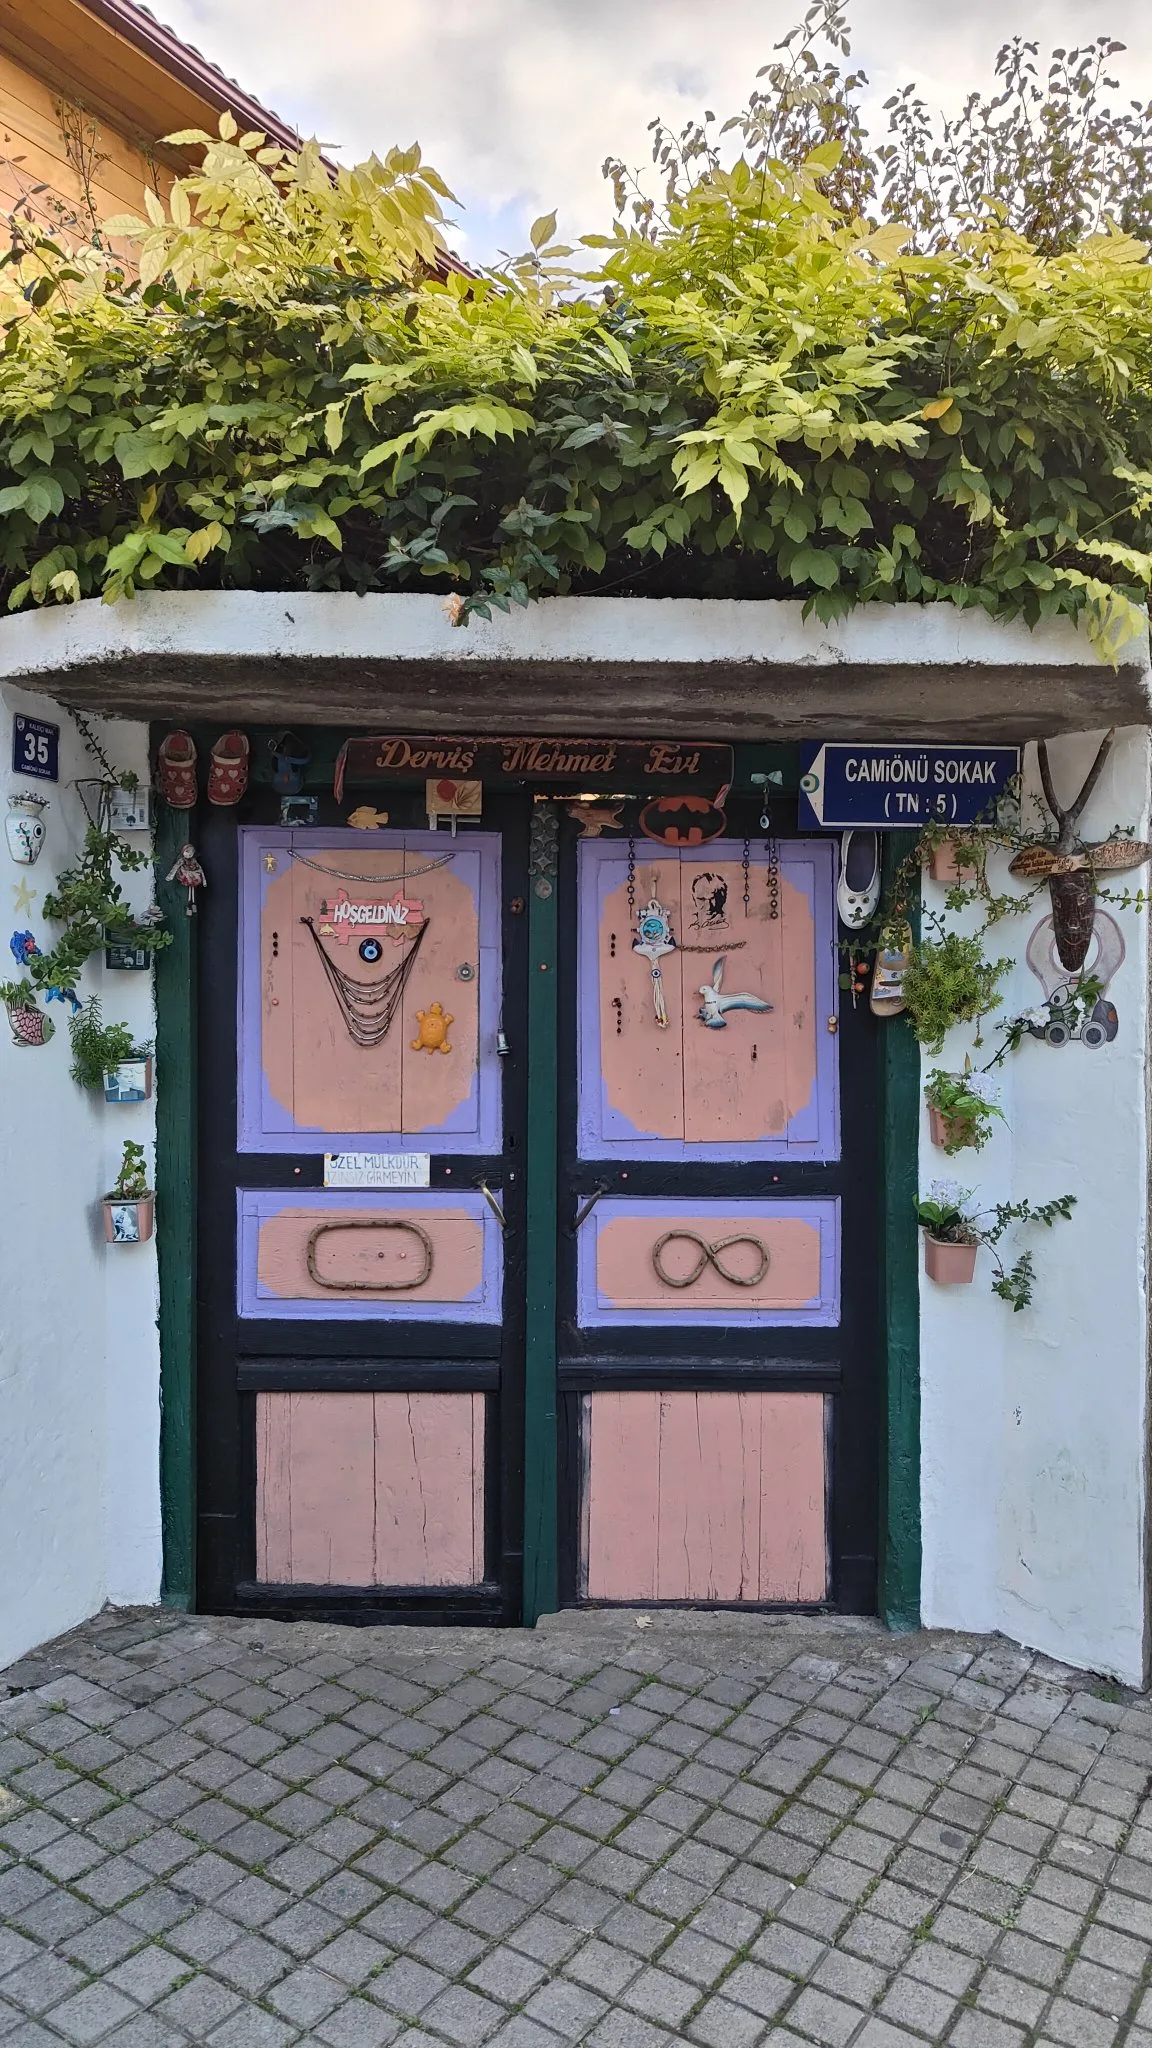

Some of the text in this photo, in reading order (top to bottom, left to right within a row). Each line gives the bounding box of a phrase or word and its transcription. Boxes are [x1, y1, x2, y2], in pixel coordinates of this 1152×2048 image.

[24, 733, 48, 764] 35
[376, 737, 701, 775] Derviş Mehmet Evi
[934, 760, 997, 784] SOKAK
